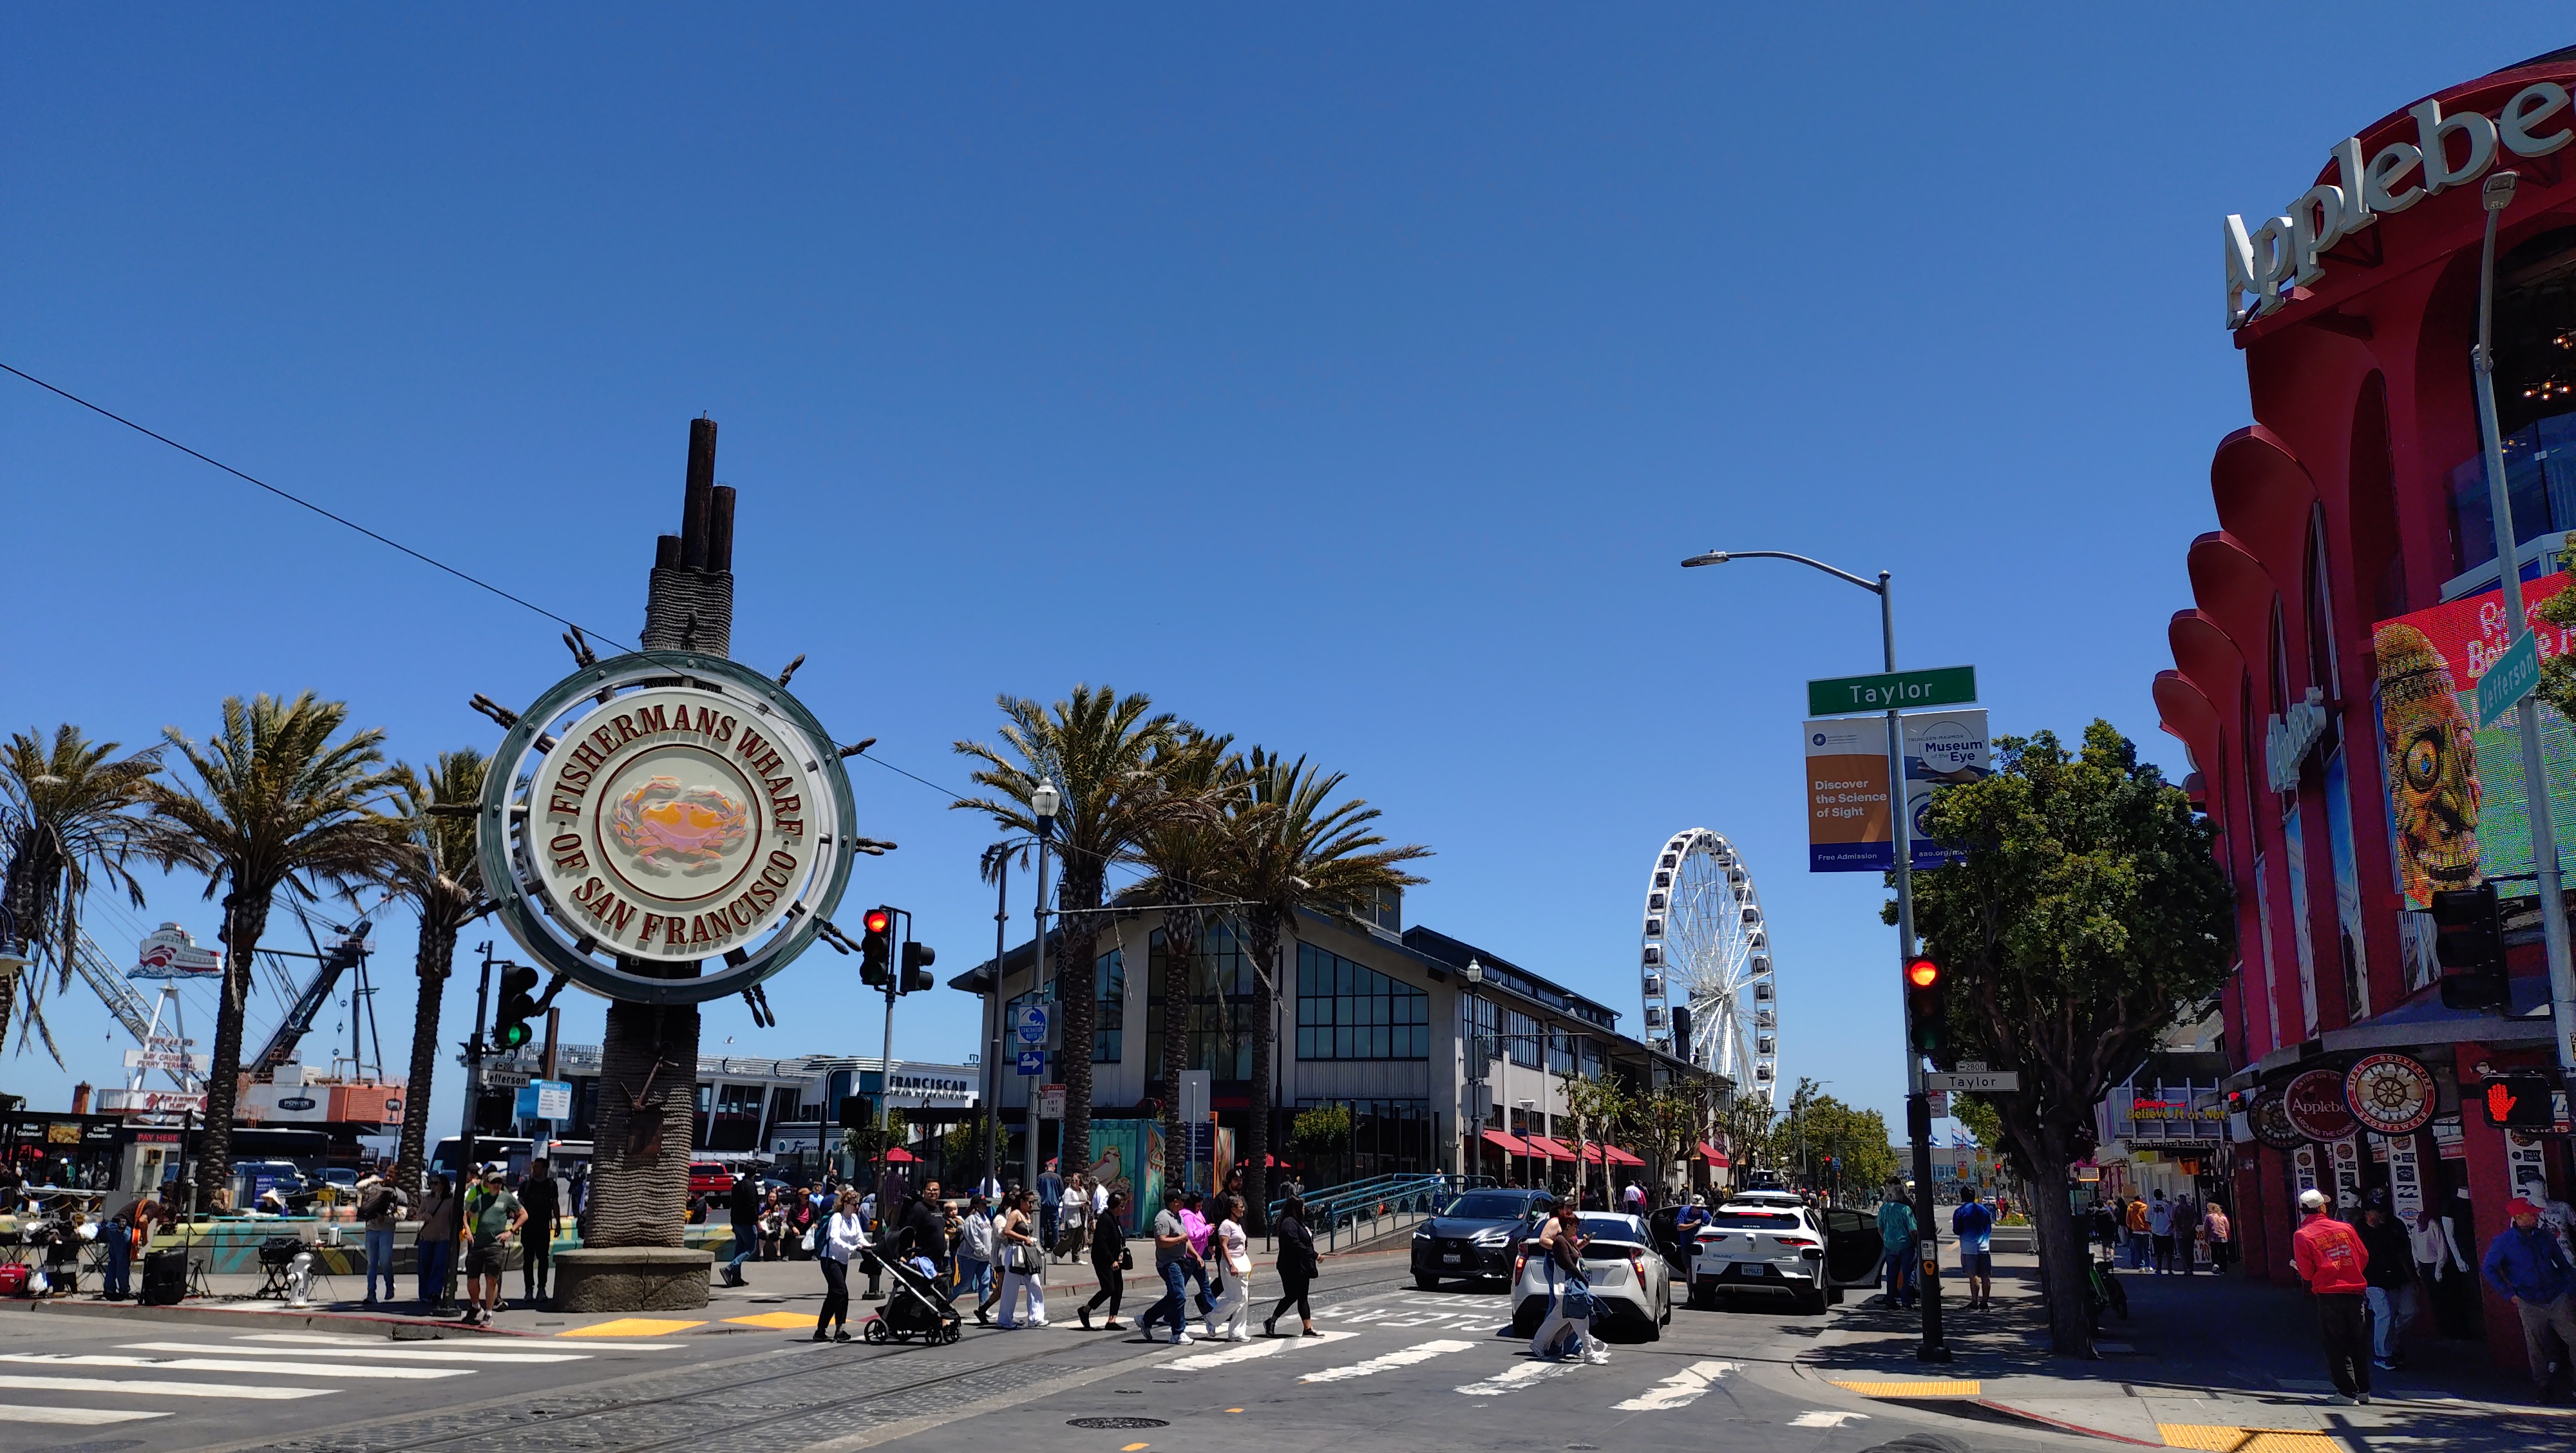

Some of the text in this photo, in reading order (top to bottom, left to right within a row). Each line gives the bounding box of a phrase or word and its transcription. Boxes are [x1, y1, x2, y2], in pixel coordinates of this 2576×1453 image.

[2224, 82, 2576, 330] Applebe
[2482, 651, 2534, 714] Jefferson
[1849, 681, 1933, 705] Taylor
[1926, 741, 1983, 752] Museum
[1950, 752, 1975, 763] Eye
[549, 704, 804, 838] FISHERMANS WHARF
[1815, 780, 1869, 790] Discover
[1816, 792, 1887, 804] the Science
[1816, 806, 1864, 819] of Sight
[1837, 851, 1877, 860] Admission
[549, 833, 797, 947] OF SAN FRANCISCO
[483, 1070, 526, 1085] Jefferson
[2347, 1055, 2432, 1090] GIFTS SOUVENIRS
[2362, 1063, 2418, 1081] WHARF
[889, 1076, 967, 1092] FRANCISCAN
[1949, 1076, 1996, 1089] Taylor
[2125, 1108, 2168, 1120] Believe
[2188, 1111, 2201, 1120] or
[2204, 1110, 2226, 1120] Not
[2291, 1097, 2347, 1115] Applebe
[2363, 1099, 2423, 1121] CENTRAL
[2358, 1111, 2429, 1131] SPORTSWEAR
[137, 1134, 154, 1142] PAY
